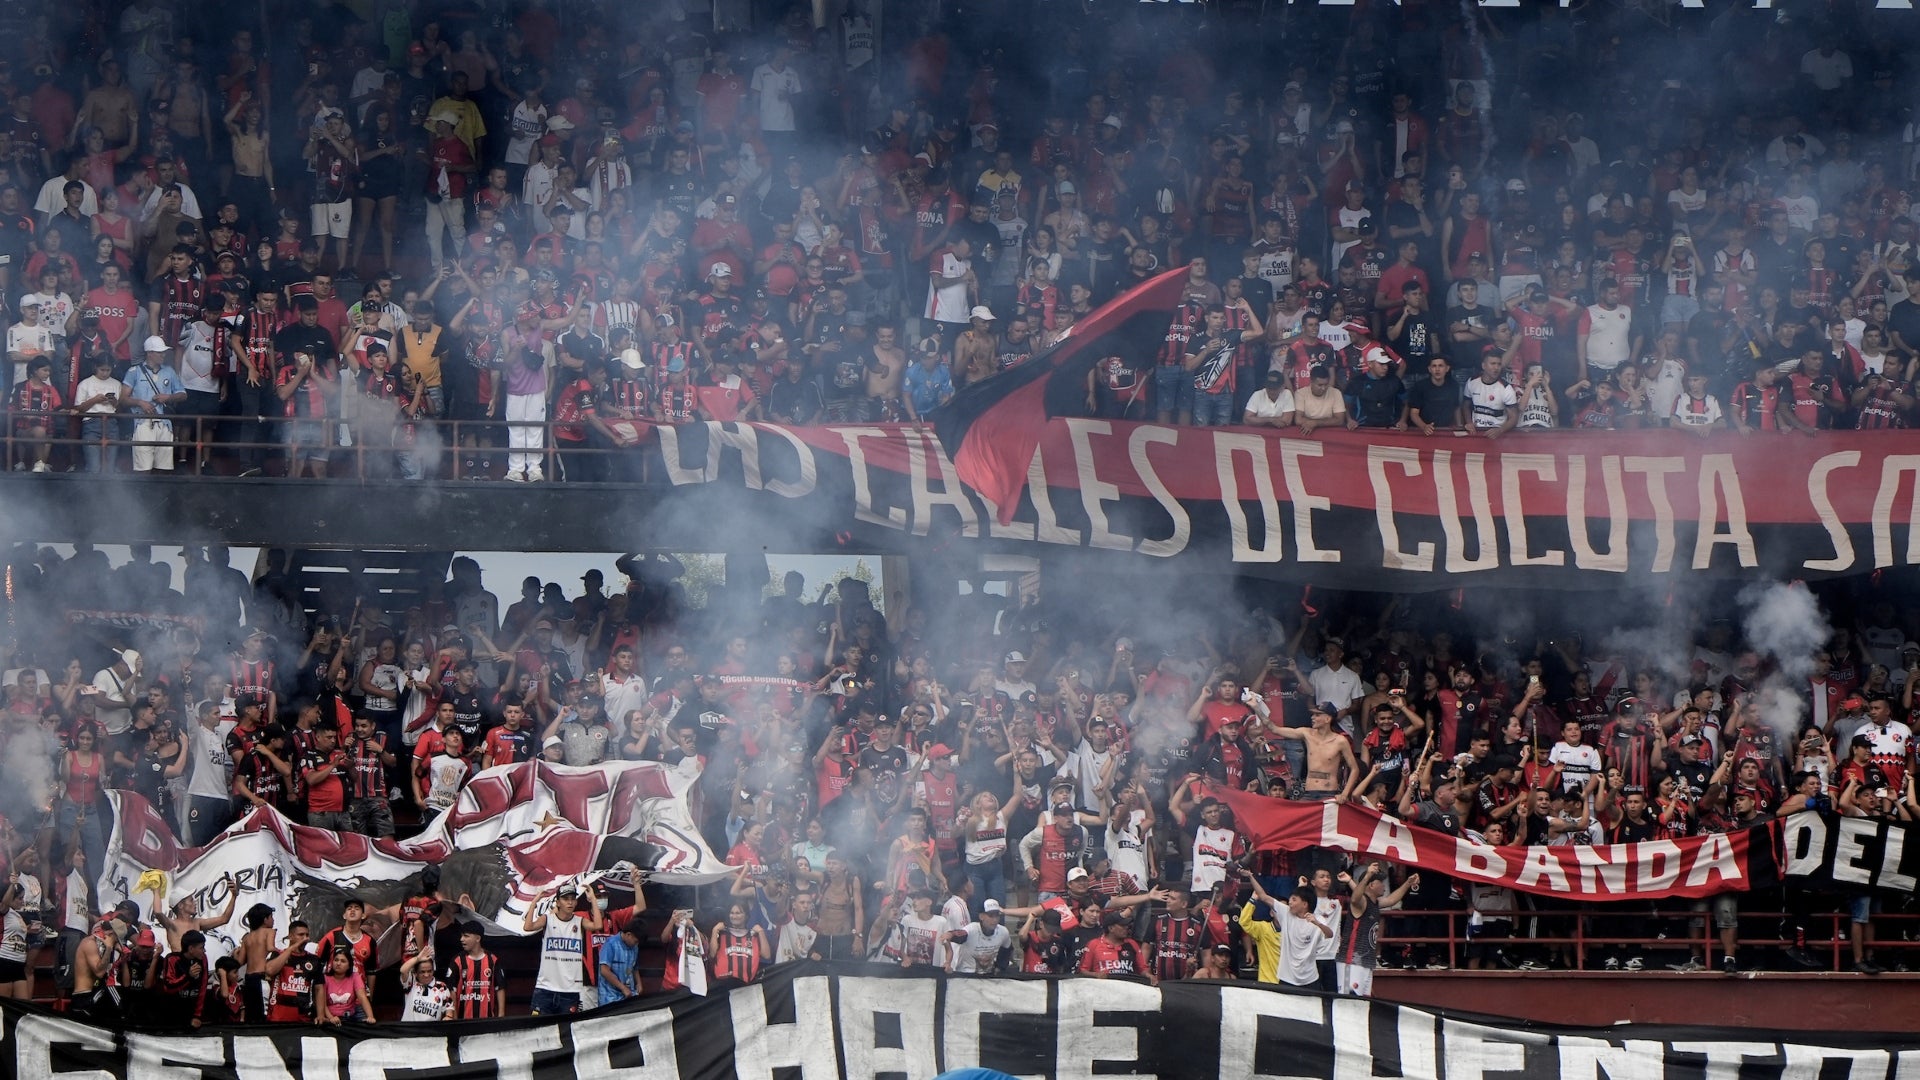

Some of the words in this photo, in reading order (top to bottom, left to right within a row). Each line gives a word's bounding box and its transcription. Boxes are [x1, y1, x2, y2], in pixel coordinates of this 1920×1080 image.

[916, 211, 944, 225] EONA
[1272, 261, 1288, 269] Cafe
[1361, 262, 1379, 271] Cafe
[95, 306, 124, 318] BOSS
[1524, 326, 1554, 337] LEONA
[1164, 333, 1190, 343] etPlay
[1213, 431, 1342, 564] DE
[1367, 444, 1759, 573] CUCUTA
[1319, 798, 1419, 862] LA
[1454, 831, 1742, 894] BANDA
[1783, 810, 1918, 892] DEL
[194, 863, 284, 913] TORIA
[548, 939, 581, 951] AGUILA
[1158, 950, 1186, 959] BetPlay
[1099, 959, 1134, 973] LEONA
[288, 975, 305, 984] Cafe
[460, 993, 485, 1002] BetPlay
[413, 999, 440, 1010] CERVEZA
[413, 1005, 439, 1018] AGUILA
[728, 974, 1164, 1080] HACE
